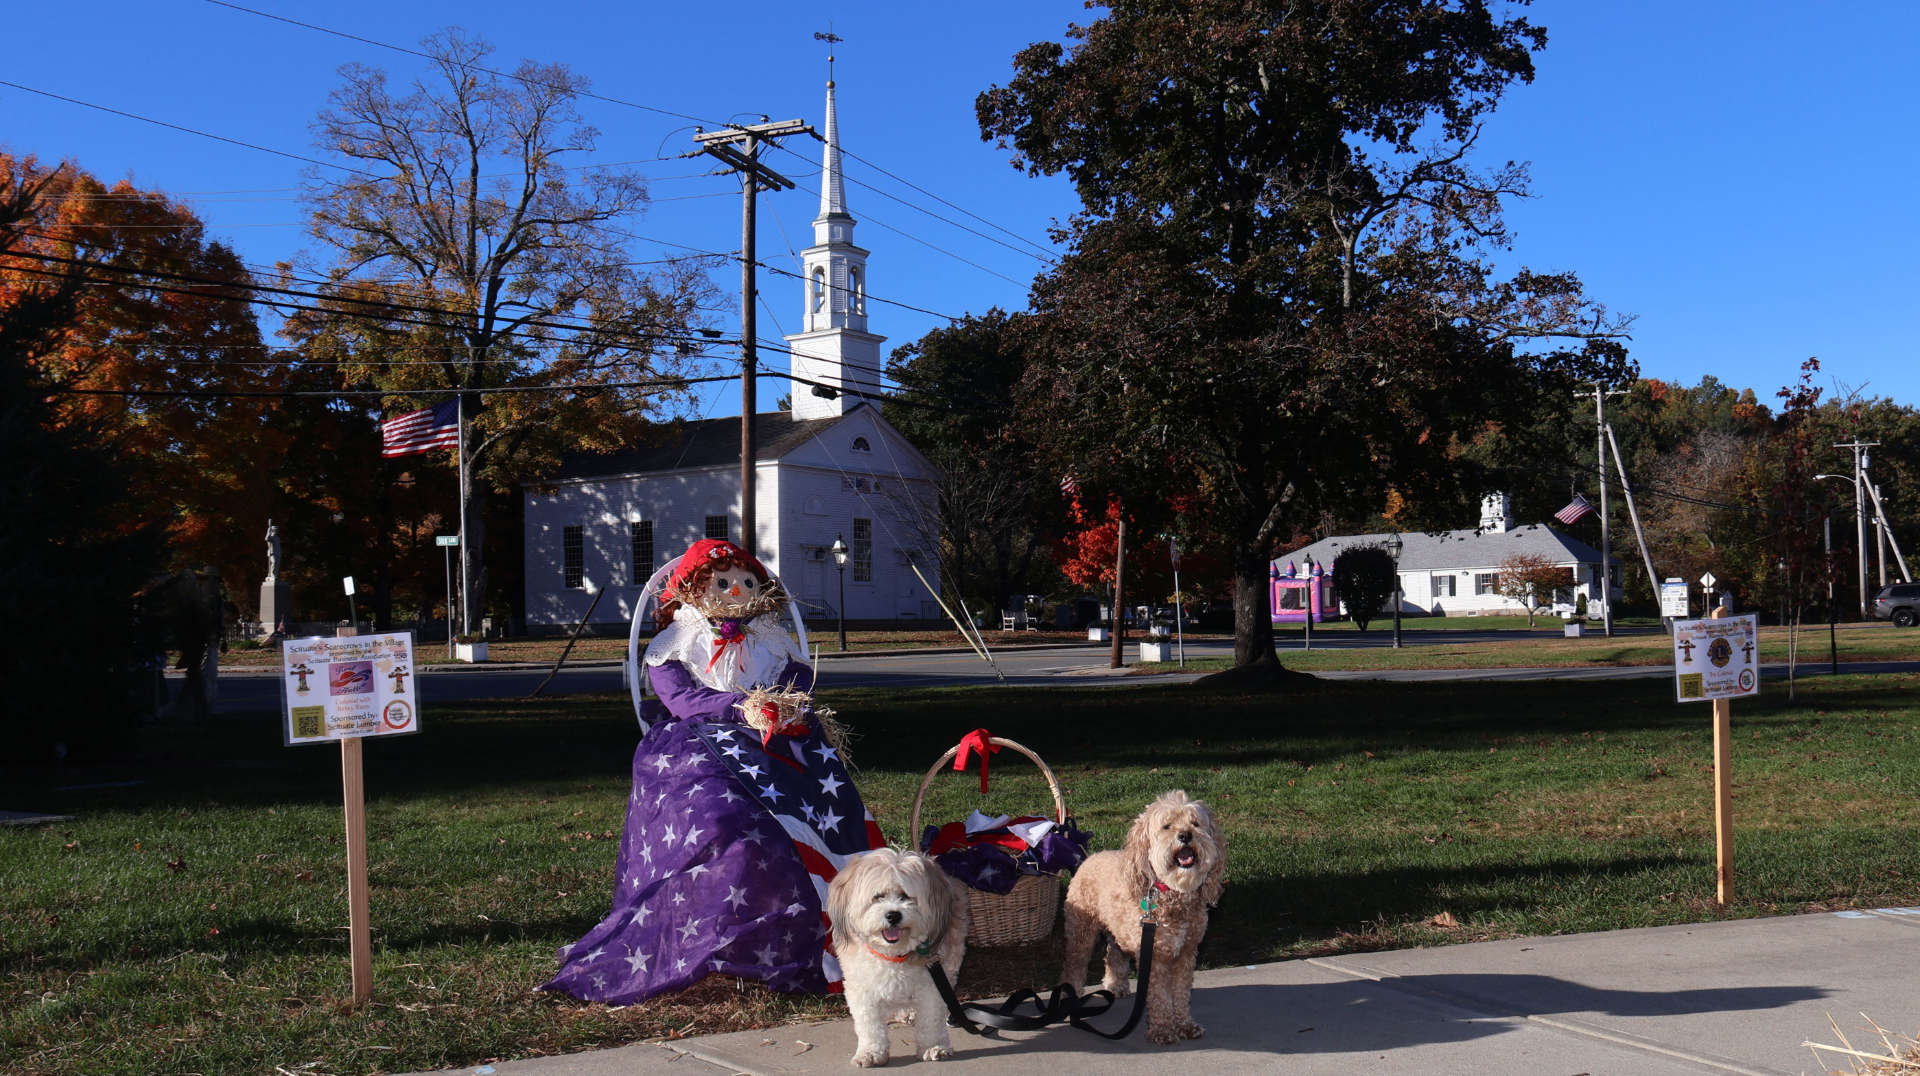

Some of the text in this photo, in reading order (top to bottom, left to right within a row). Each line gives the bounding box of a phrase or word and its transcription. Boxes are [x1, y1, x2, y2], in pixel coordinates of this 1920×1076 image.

[325, 642, 363, 651] Scarecrows
[384, 639, 405, 647] Village
[330, 712, 367, 722] Sponsored
